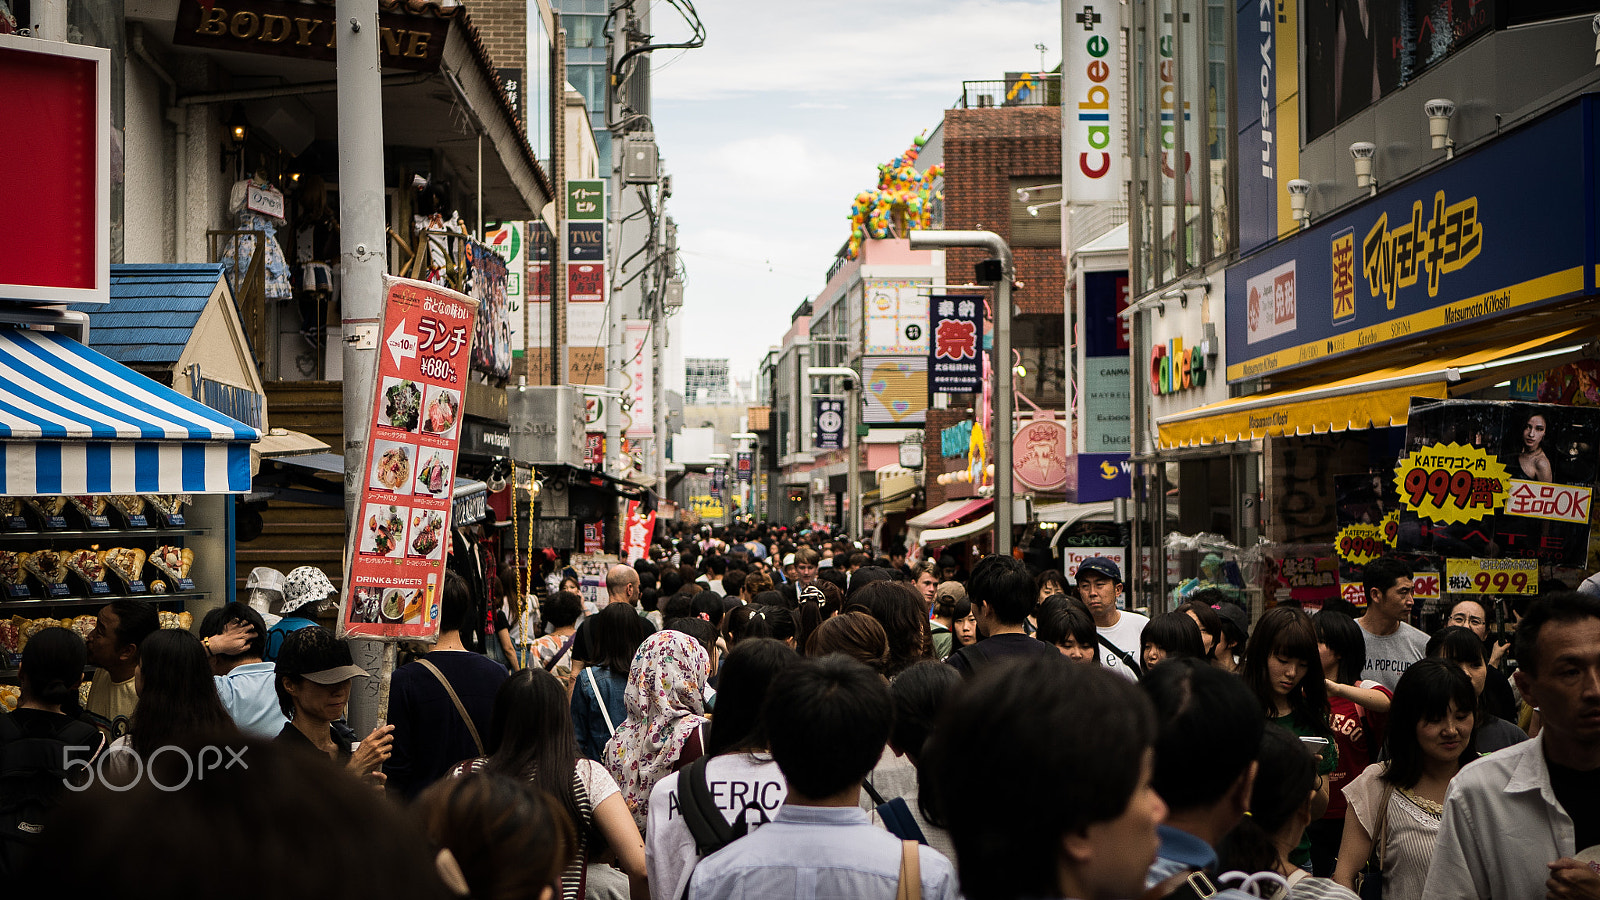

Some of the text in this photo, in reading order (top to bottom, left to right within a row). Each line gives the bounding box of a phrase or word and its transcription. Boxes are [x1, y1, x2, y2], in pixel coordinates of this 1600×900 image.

[196, 6, 431, 59] BODY NE
[1079, 35, 1110, 179] Calbee
[254, 193, 281, 209] Open
[571, 188, 600, 199] イトー
[577, 201, 596, 212] ビル
[570, 230, 601, 243] TWC
[1333, 190, 1482, 314] 薬 マツモトキヨシ
[571, 272, 601, 282] かっぱ
[576, 282, 596, 292] 寿司
[423, 296, 469, 320] おとなの味わい
[1275, 279, 1293, 318] 免税
[1444, 290, 1511, 325] Matsumoto KiYoshi
[418, 316, 467, 359] ランチ
[935, 318, 977, 361] 祭
[1100, 369, 1130, 377] CANMA
[1151, 336, 1206, 396] Calbee
[1103, 434, 1130, 444] Ducat
[1016, 450, 1039, 468] SANTA
[1415, 455, 1486, 470] KATEワゴン内
[1404, 468, 1502, 509] 999 税込 円
[1511, 484, 1590, 518] 全品OK
[1340, 536, 1374, 557] 999
[1422, 525, 1564, 548] KATE
[1519, 549, 1563, 560] TOKYO
[1449, 572, 1536, 593] 税込 999 円
[669, 781, 781, 820] AERIC
